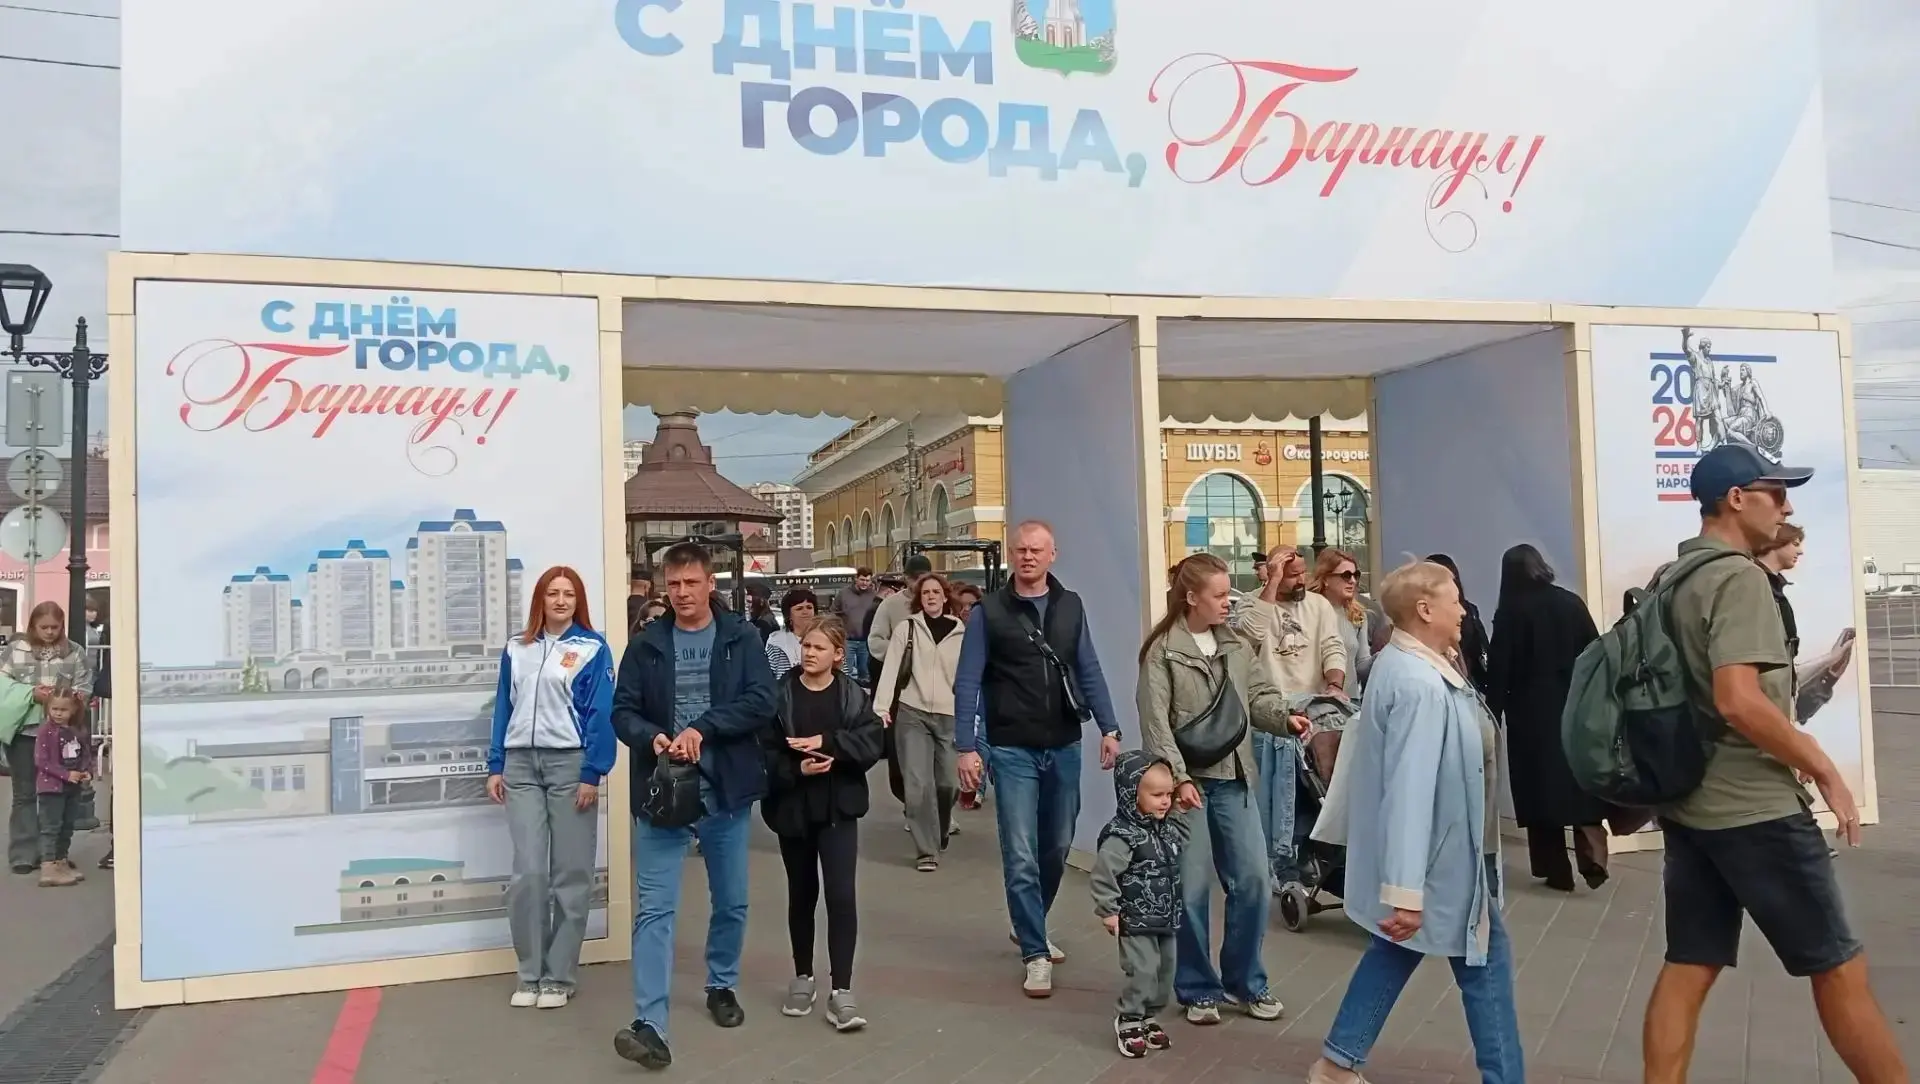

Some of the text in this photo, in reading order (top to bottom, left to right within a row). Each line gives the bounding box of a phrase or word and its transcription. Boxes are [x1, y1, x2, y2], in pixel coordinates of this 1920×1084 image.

[614, 0, 994, 85] С ДНЁМ
[740, 52, 1546, 253] ГОРОДА, Барнаул!
[261, 295, 456, 340] С ДНЁМ
[355, 338, 570, 383] ГОРОДА,
[1650, 363, 1695, 405] 20
[166, 338, 519, 477] Барнаул!
[1652, 405, 1696, 446] 26
[1186, 443, 1242, 462] ШУБЫ
[1656, 463, 1680, 476] ГОД
[1656, 477, 1691, 489] НАРО
[682, 647, 696, 661] ON
